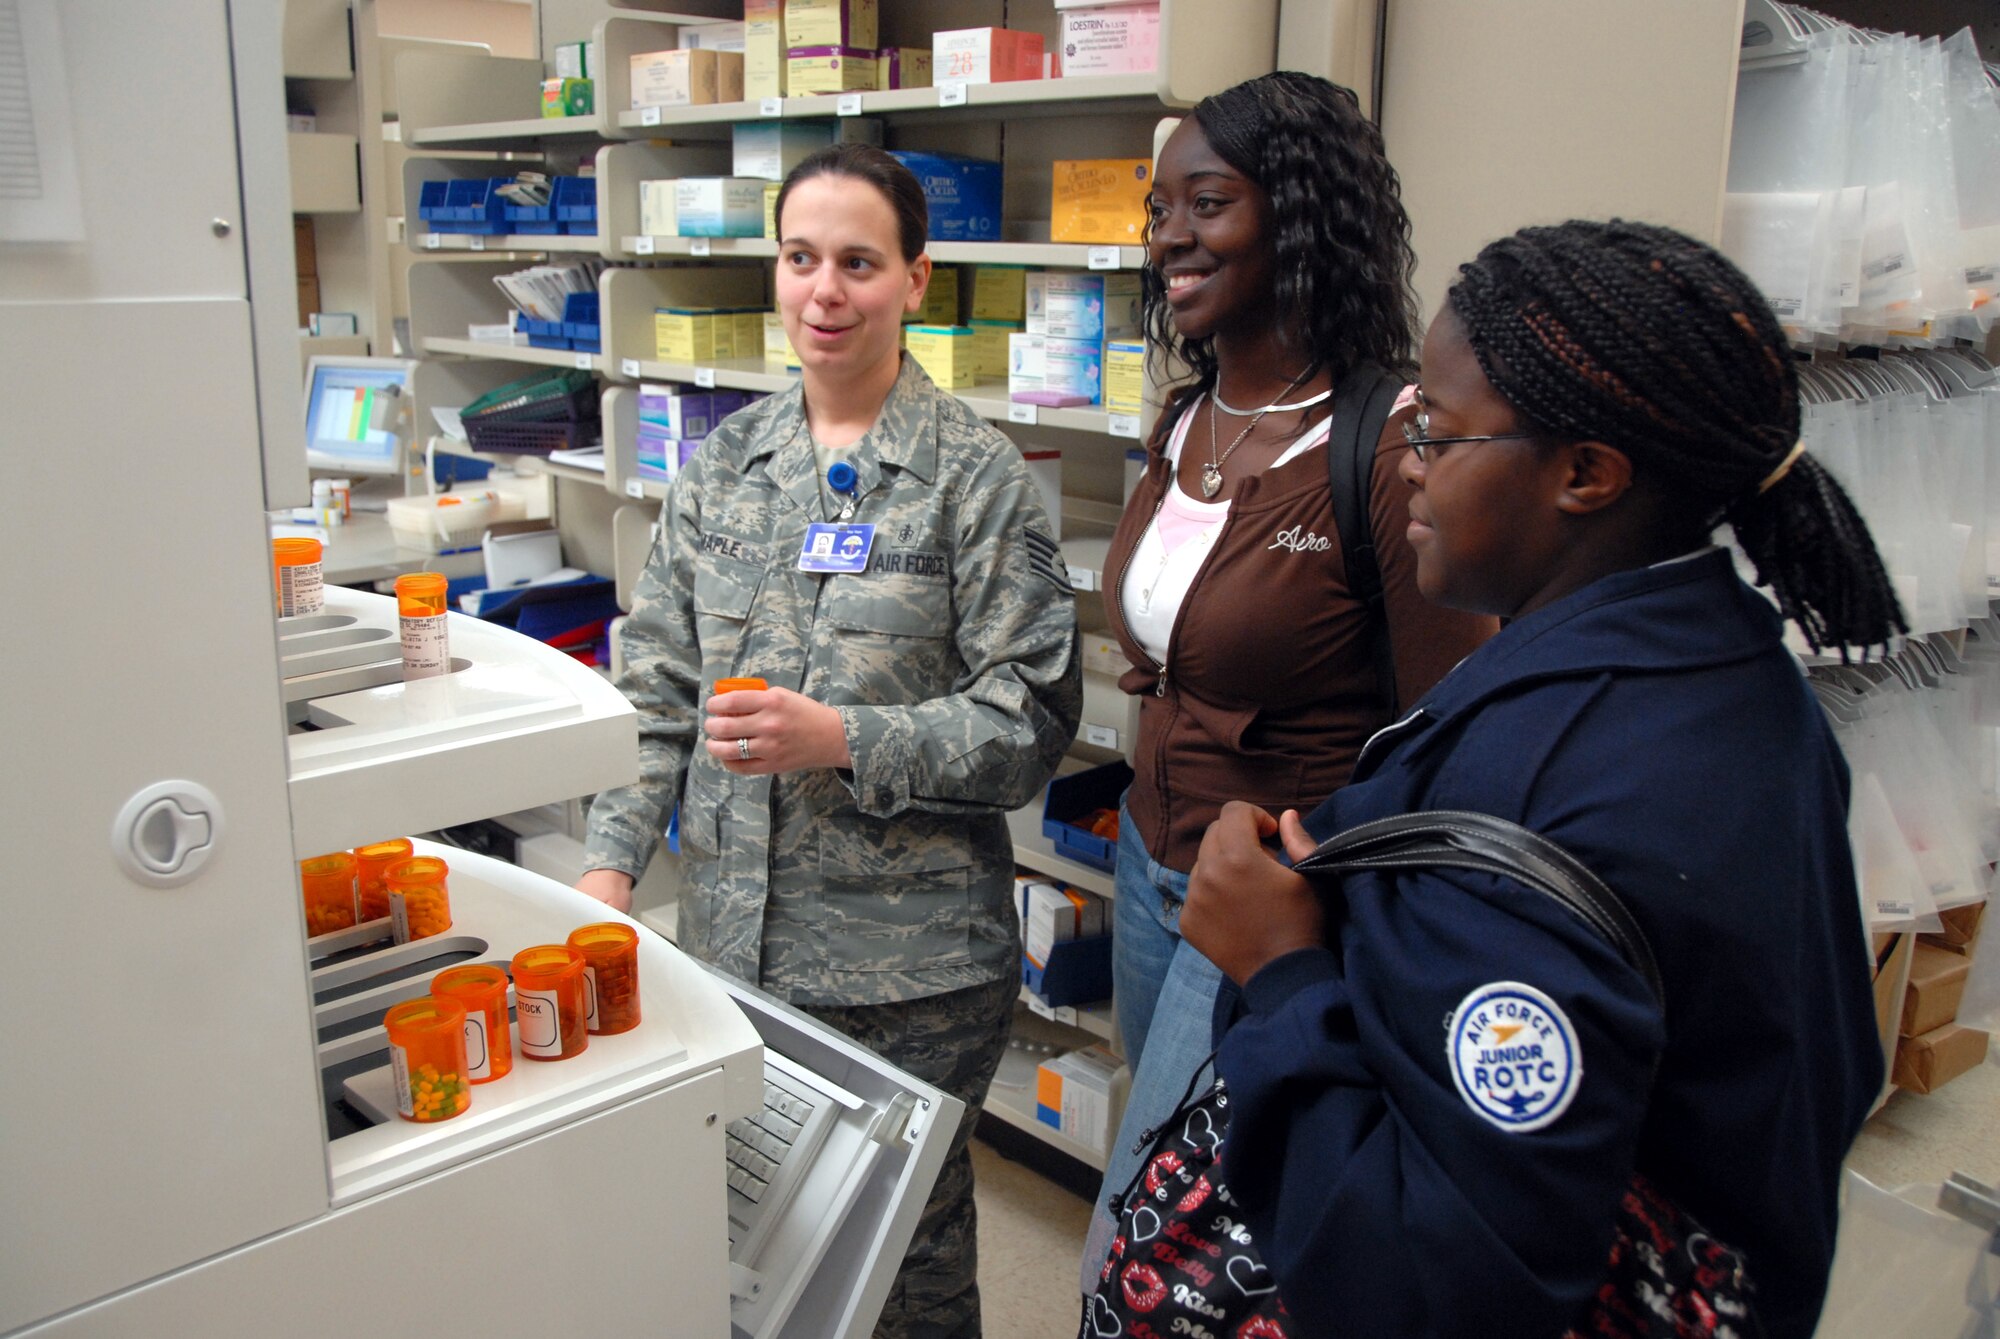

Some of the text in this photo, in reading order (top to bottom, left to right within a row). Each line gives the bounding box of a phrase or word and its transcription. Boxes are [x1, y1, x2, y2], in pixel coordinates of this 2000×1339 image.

[1069, 20, 1104, 31] LOESTRIN
[949, 49, 973, 75] 28
[1268, 524, 1332, 553] Aero
[874, 553, 946, 576] AIR FORCE
[518, 1000, 542, 1014] STOCK
[1467, 1002, 1553, 1045] AIR FORCE
[1477, 1044, 1544, 1065] JUNIOR
[1473, 1060, 1557, 1090] ROTC
[1210, 1215, 1252, 1245] Me
[1173, 1284, 1226, 1320] Kiss
